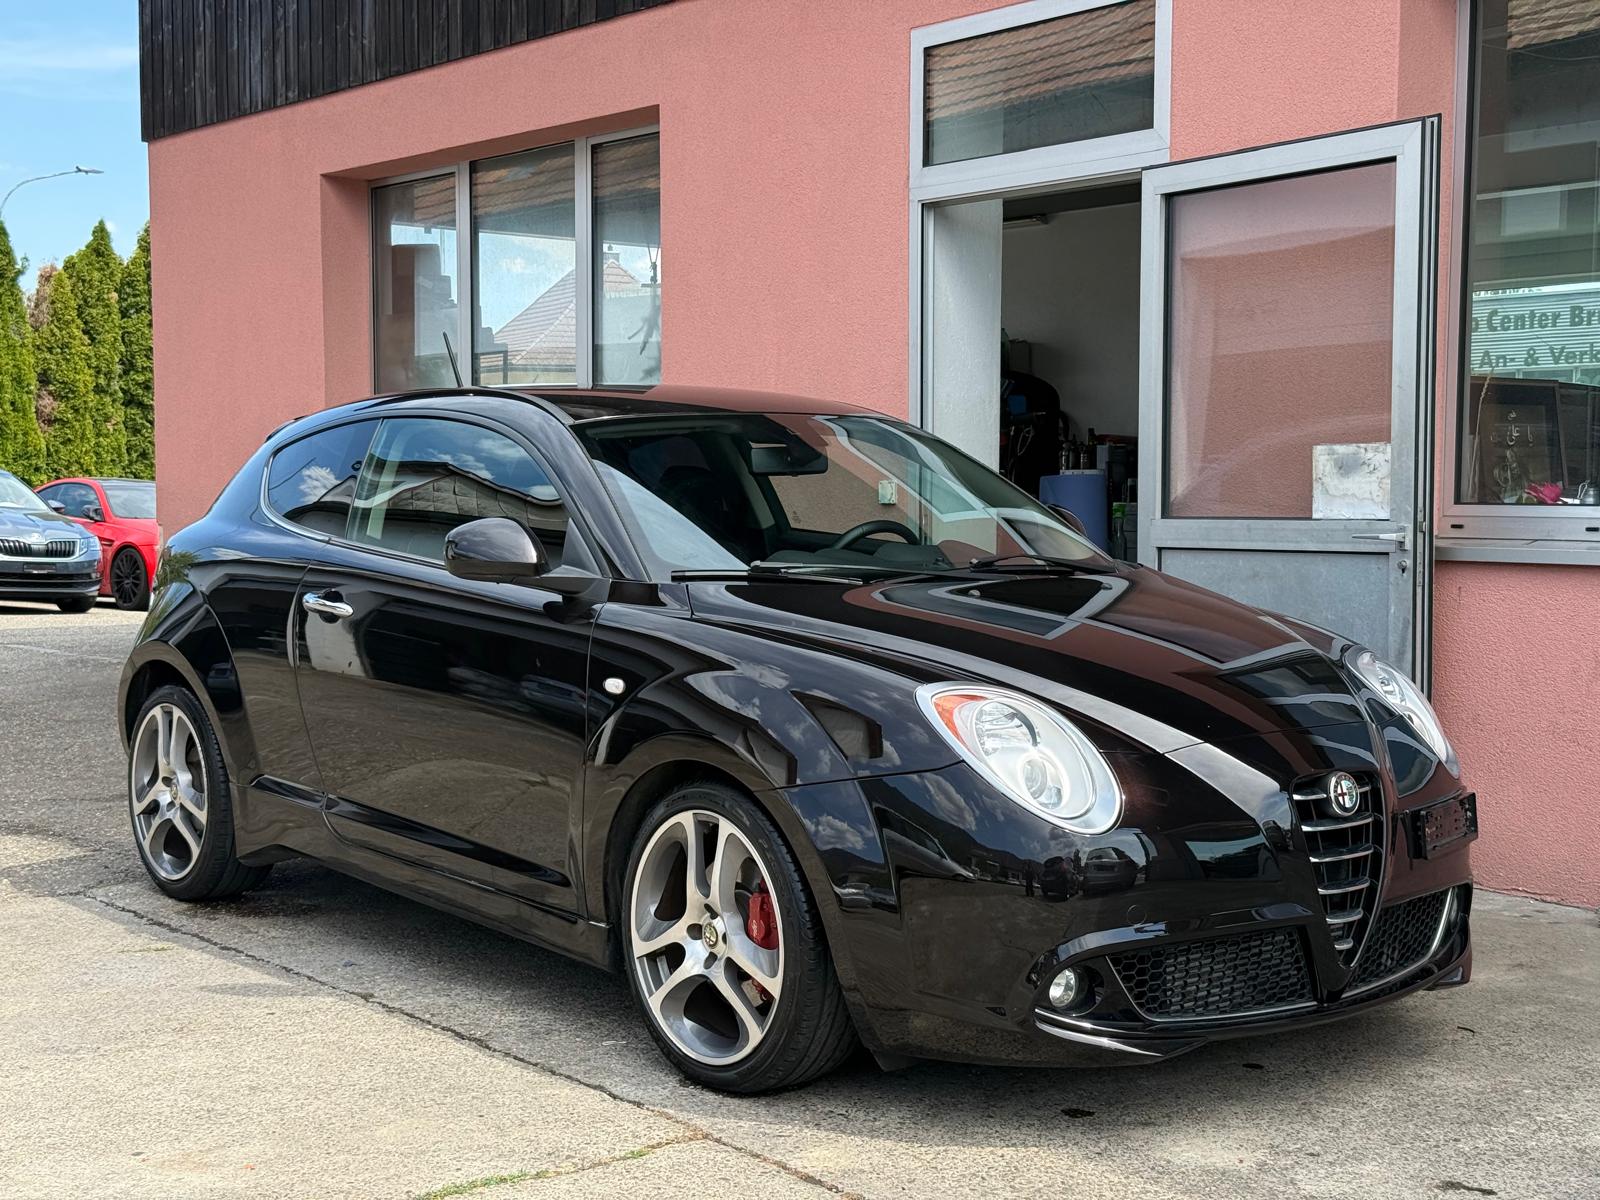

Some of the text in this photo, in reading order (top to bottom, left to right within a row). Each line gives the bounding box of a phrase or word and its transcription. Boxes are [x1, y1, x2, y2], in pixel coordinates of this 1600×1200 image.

[1487, 308, 1560, 332] Center
[1480, 343, 1600, 368] An- & Verk
